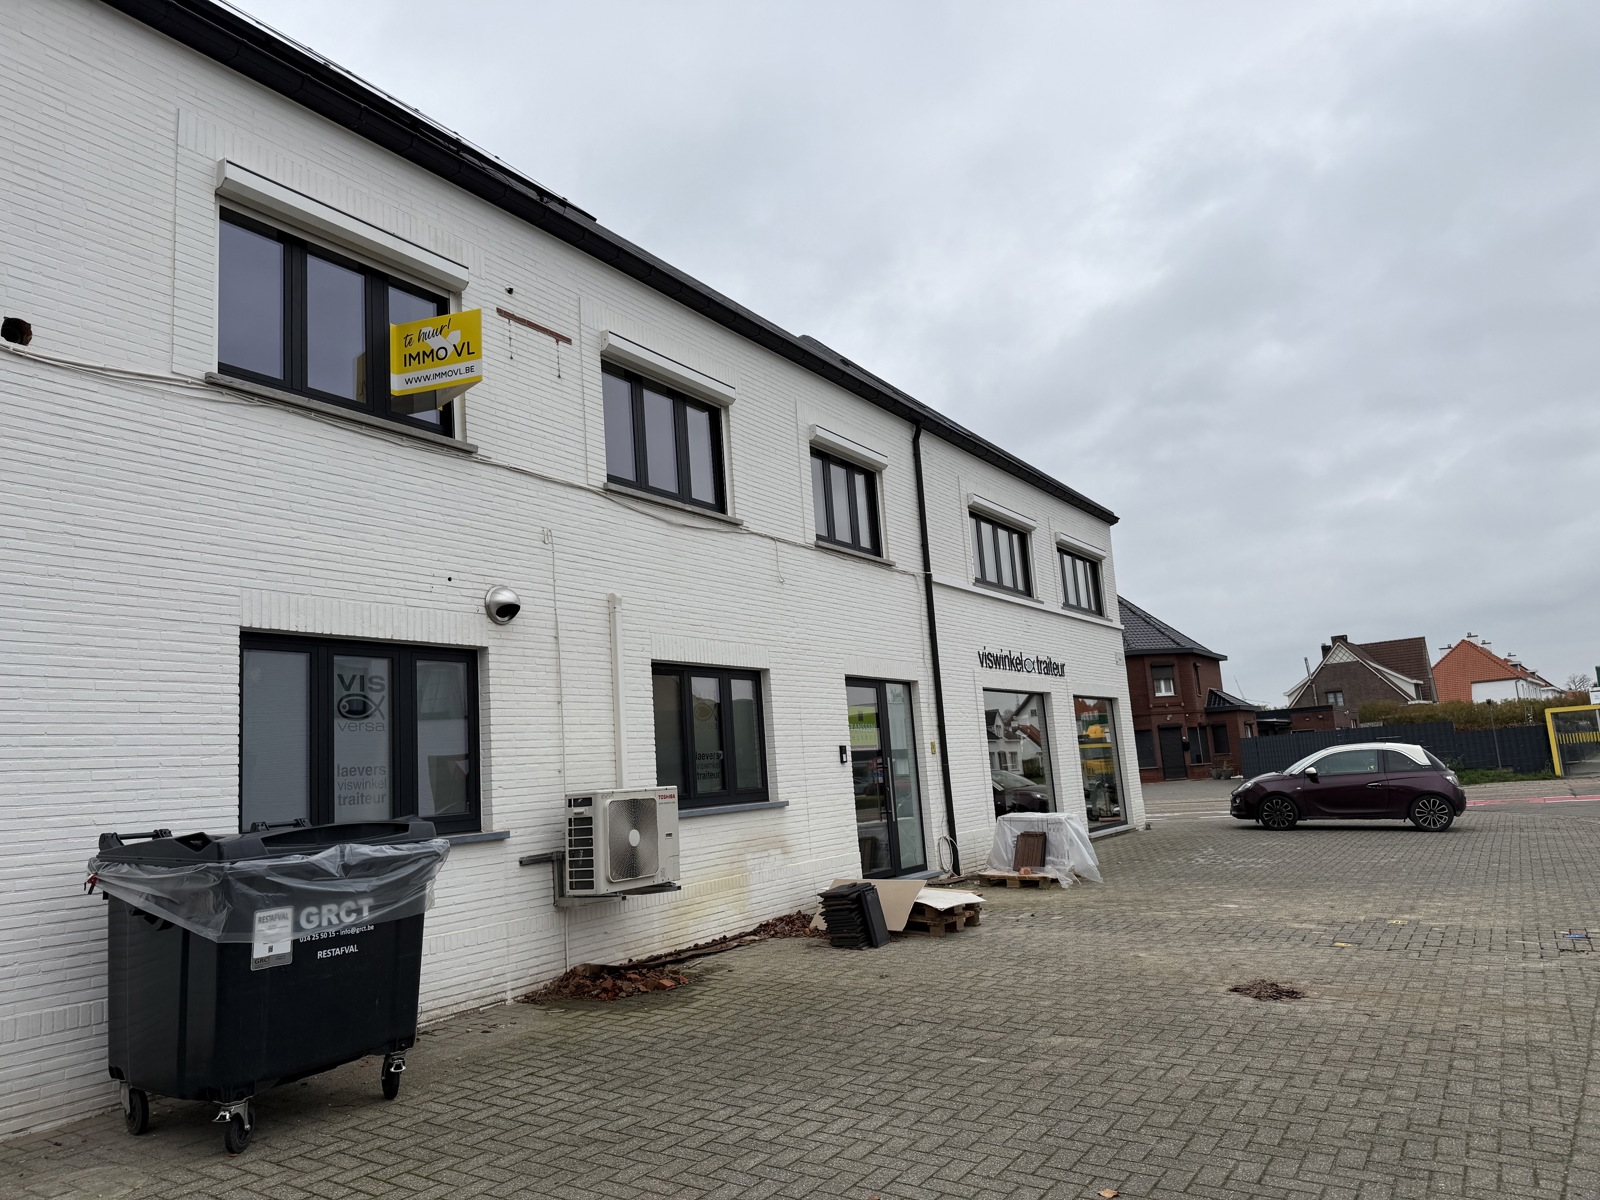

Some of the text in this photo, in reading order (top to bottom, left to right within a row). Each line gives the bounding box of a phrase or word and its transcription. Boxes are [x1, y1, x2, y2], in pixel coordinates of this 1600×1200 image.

[403, 317, 452, 348] te huur!
[404, 365, 475, 385] WWW.IMMOVL.BE
[977, 646, 1066, 677] viswinkel traiteur
[336, 673, 386, 693] VIS
[337, 721, 386, 732] versa
[336, 764, 386, 777] laevers
[337, 777, 387, 791] viswinkel
[337, 793, 386, 807] traiteur
[257, 912, 289, 924] RESTAFVAL
[300, 898, 374, 930] GRCT
[320, 931, 328, 939] 50
[317, 944, 359, 959] RESTAFVAL
